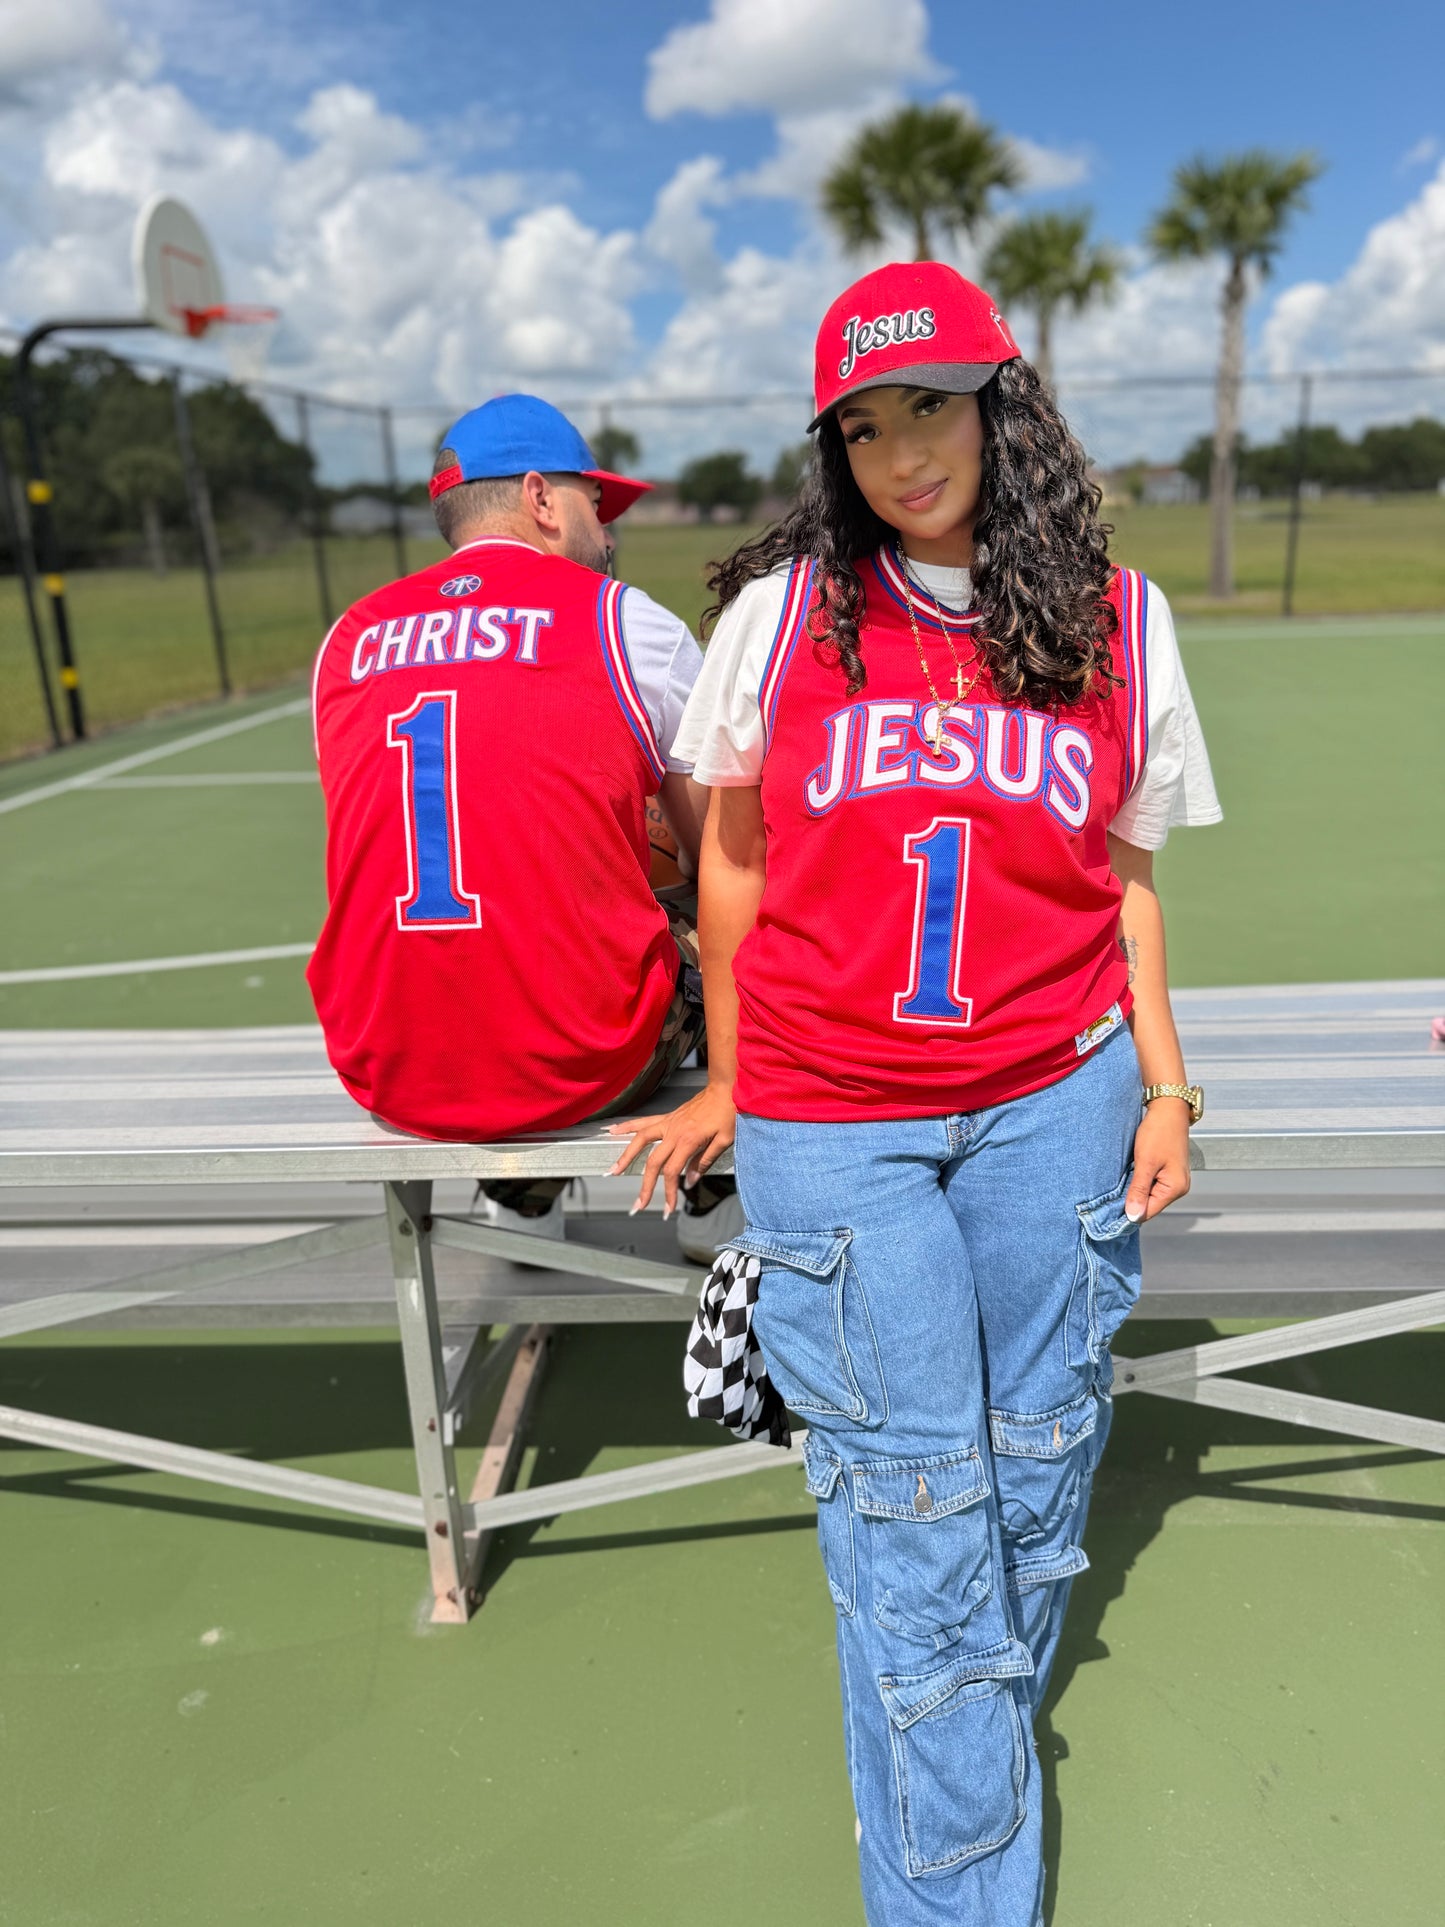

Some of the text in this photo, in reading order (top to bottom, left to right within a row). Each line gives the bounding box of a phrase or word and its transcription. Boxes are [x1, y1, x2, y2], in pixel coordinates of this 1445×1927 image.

[837, 306, 937, 380] Jesus
[349, 606, 554, 684] CHRIST
[386, 690, 482, 931] 1
[803, 699, 1095, 833] JESUS
[892, 816, 973, 1027] 1
